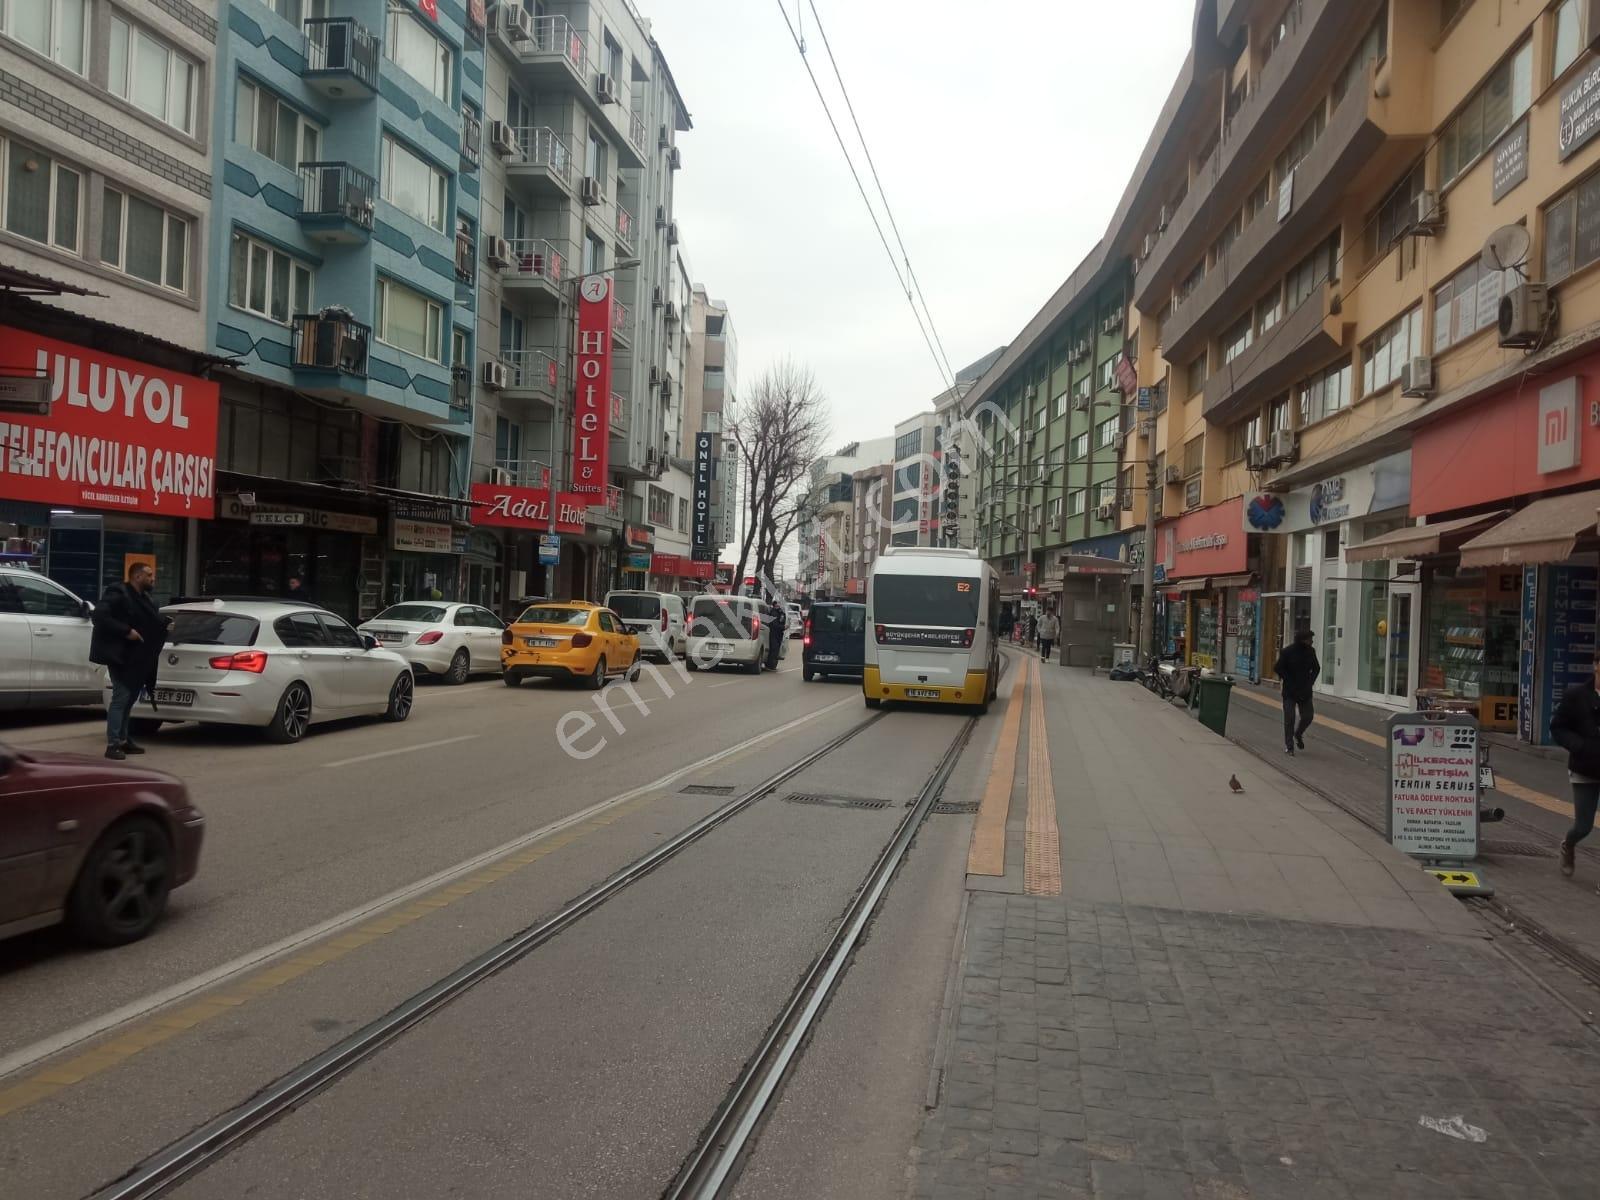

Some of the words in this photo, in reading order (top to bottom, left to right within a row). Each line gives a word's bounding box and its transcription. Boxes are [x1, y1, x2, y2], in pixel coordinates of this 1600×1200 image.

[36, 349, 189, 429] ULUYOL
[0, 421, 147, 491] TELEFONCULAR
[151, 448, 214, 509] ÇARŞISI
[581, 466, 593, 479] &
[572, 482, 602, 494] Suites
[697, 489, 706, 544] HOTEL
[957, 582, 970, 592] E2
[1553, 573, 1568, 637] HAMZA
[175, 691, 192, 703] 910
[1418, 767, 1469, 778] İLETİŞİM
[1420, 794, 1444, 802] ÖDEME
[1445, 795, 1475, 804] NOKTASI
[1416, 808, 1437, 816] PAKET
